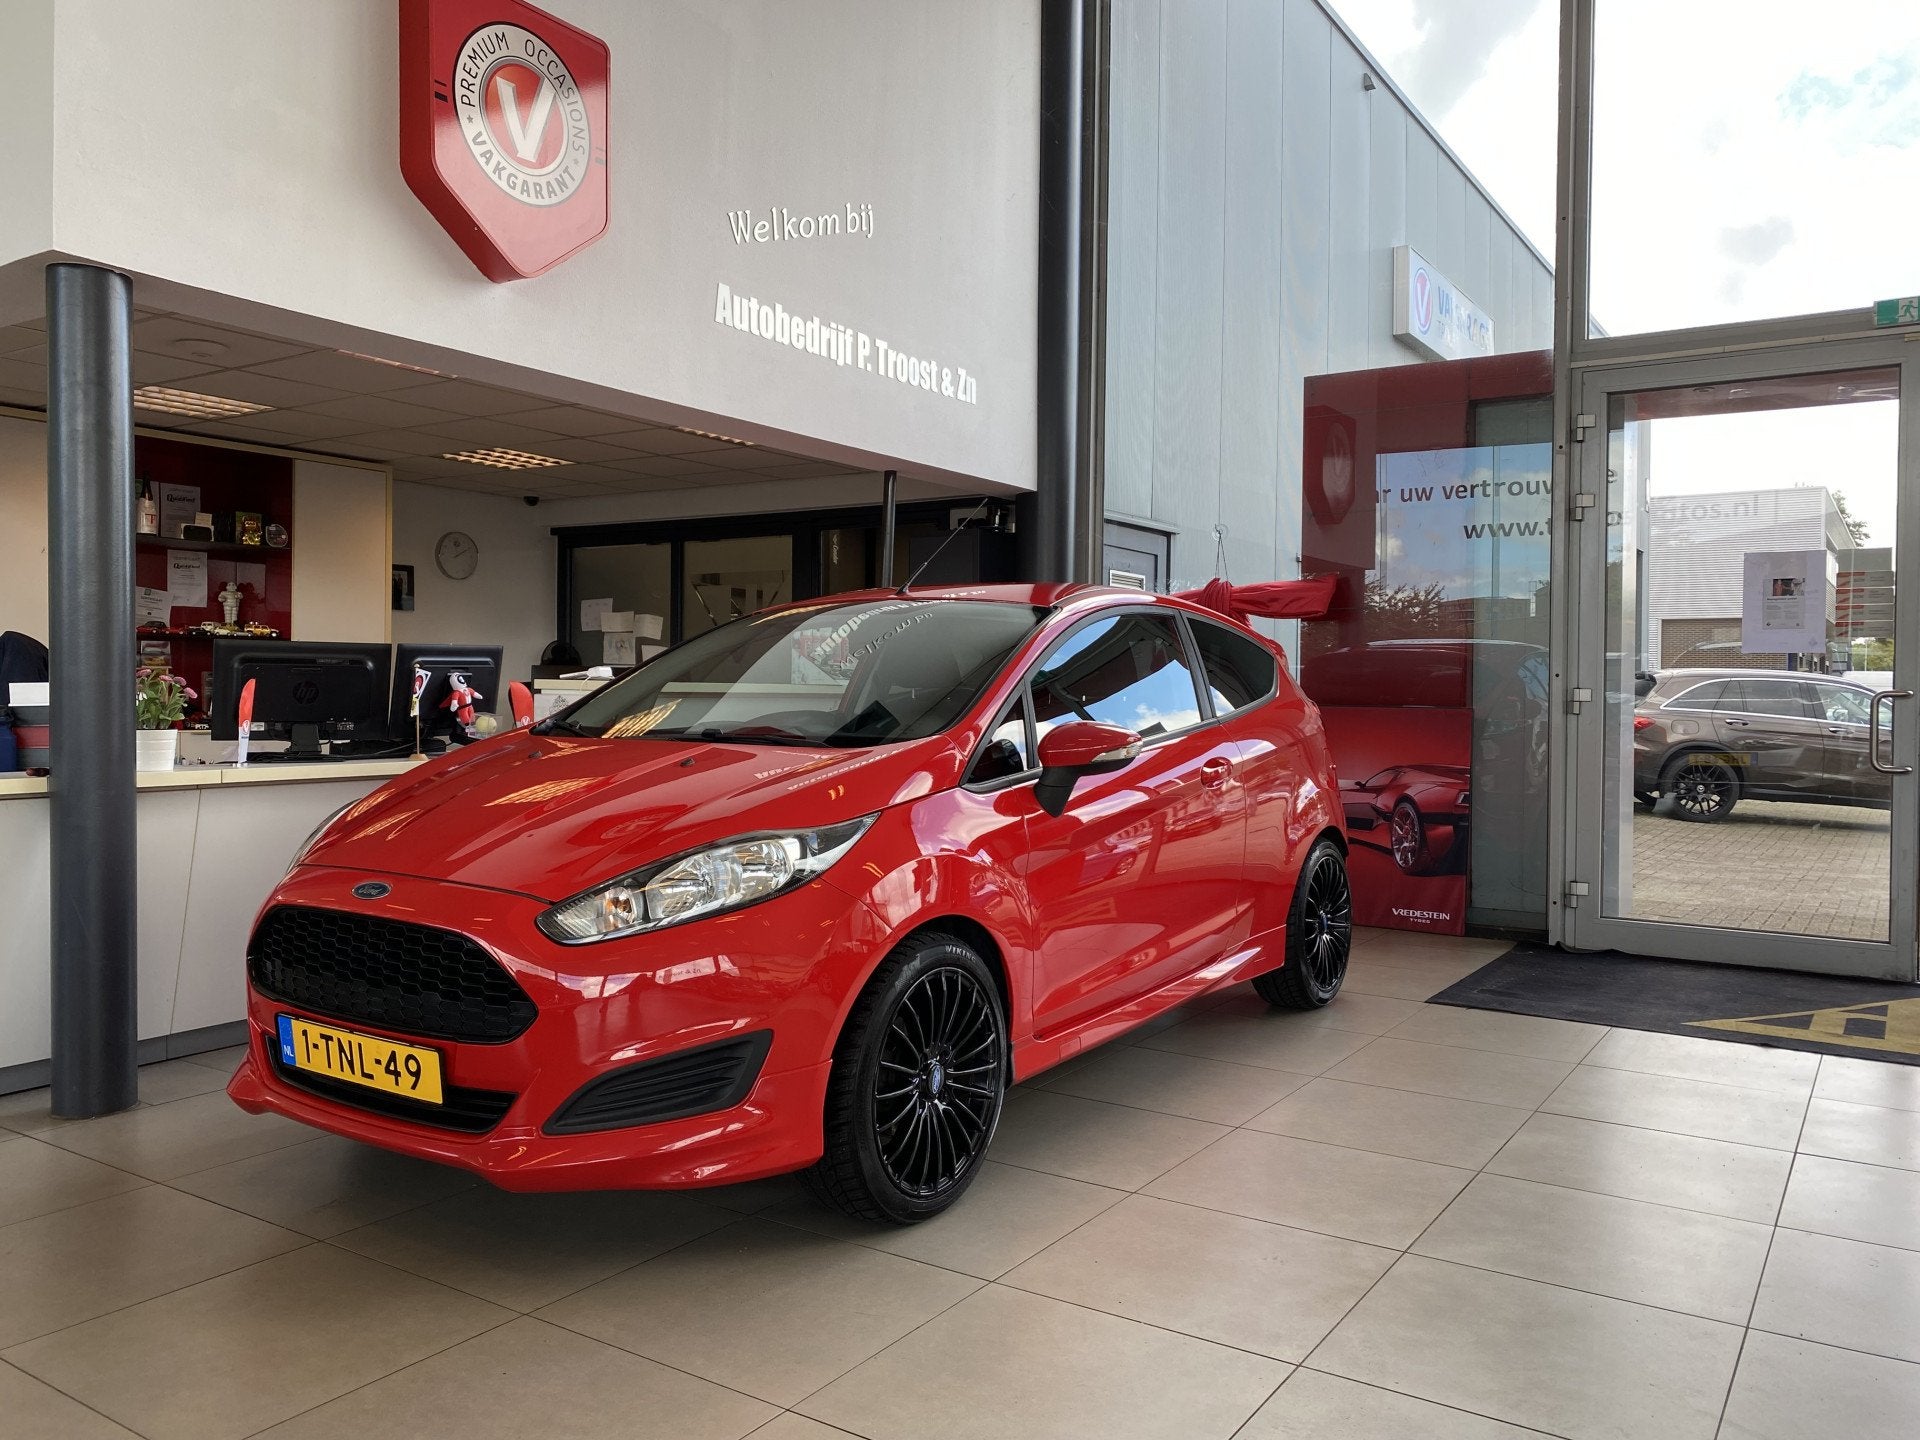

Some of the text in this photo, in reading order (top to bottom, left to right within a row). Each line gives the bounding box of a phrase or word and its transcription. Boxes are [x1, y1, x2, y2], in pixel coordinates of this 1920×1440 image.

[461, 31, 585, 155] PREMIUM OCCASIONS
[471, 131, 576, 199] VAKGARANT
[727, 202, 874, 245] Welkom bij
[714, 282, 977, 405] Autobedrijf P. Troost & Zn
[1401, 486, 1434, 503] uw
[1391, 907, 1450, 920] VREDESTEIN
[283, 1045, 294, 1057] NL
[302, 1029, 421, 1091] 1-TNL-49
